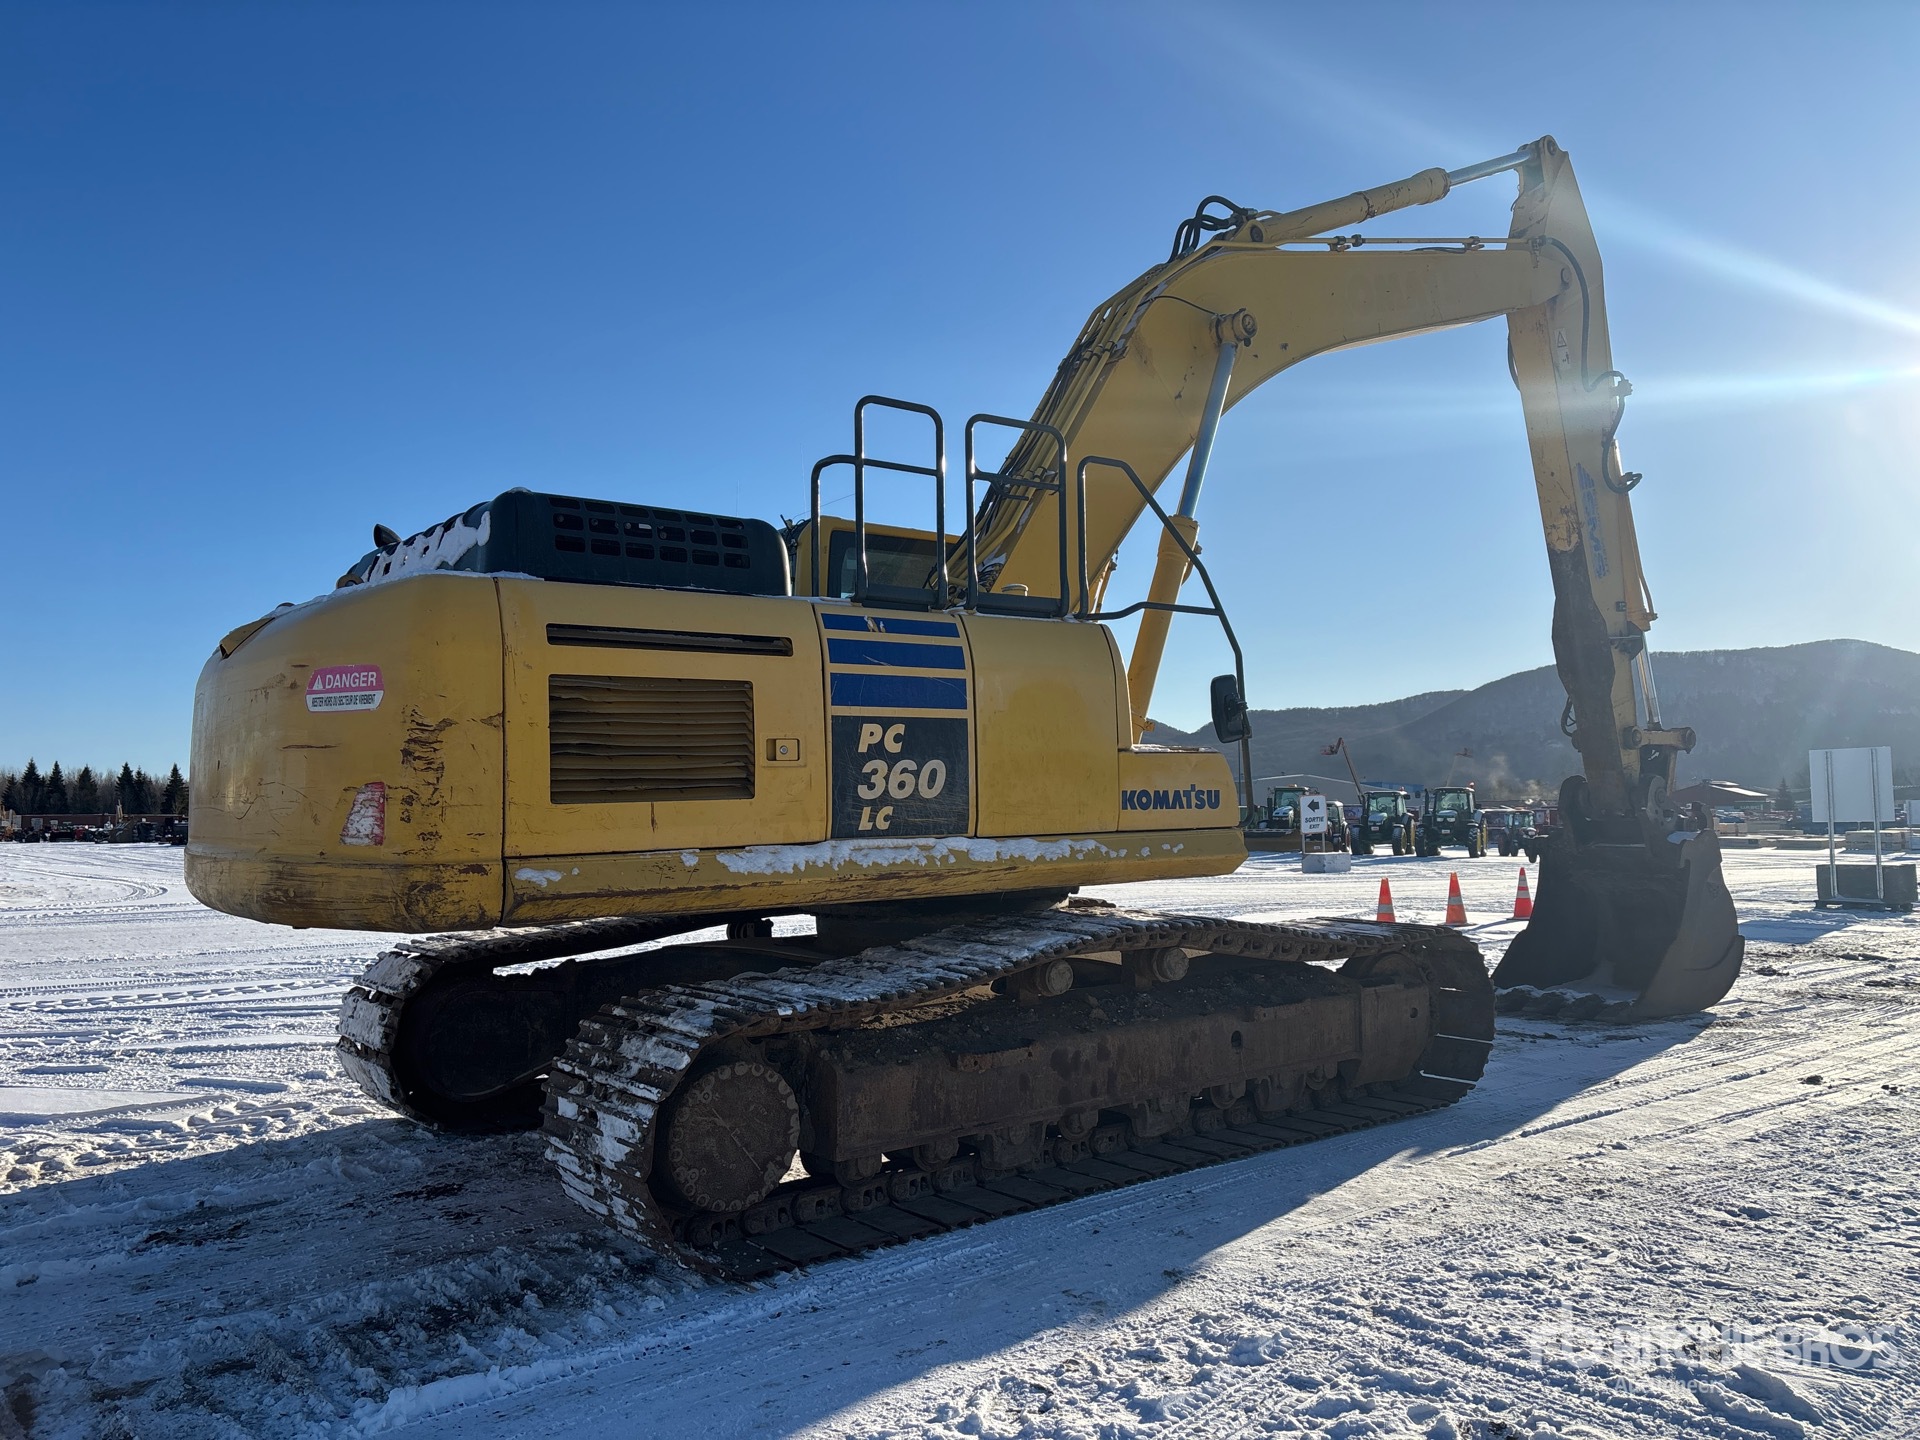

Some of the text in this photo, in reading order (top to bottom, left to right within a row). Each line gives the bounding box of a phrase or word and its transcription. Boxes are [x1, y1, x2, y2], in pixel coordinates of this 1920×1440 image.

[325, 671, 377, 689] DANGER
[857, 723, 906, 754] PC
[857, 759, 947, 800] 360
[1121, 784, 1221, 811] KOMATSU
[857, 806, 894, 831] LC
